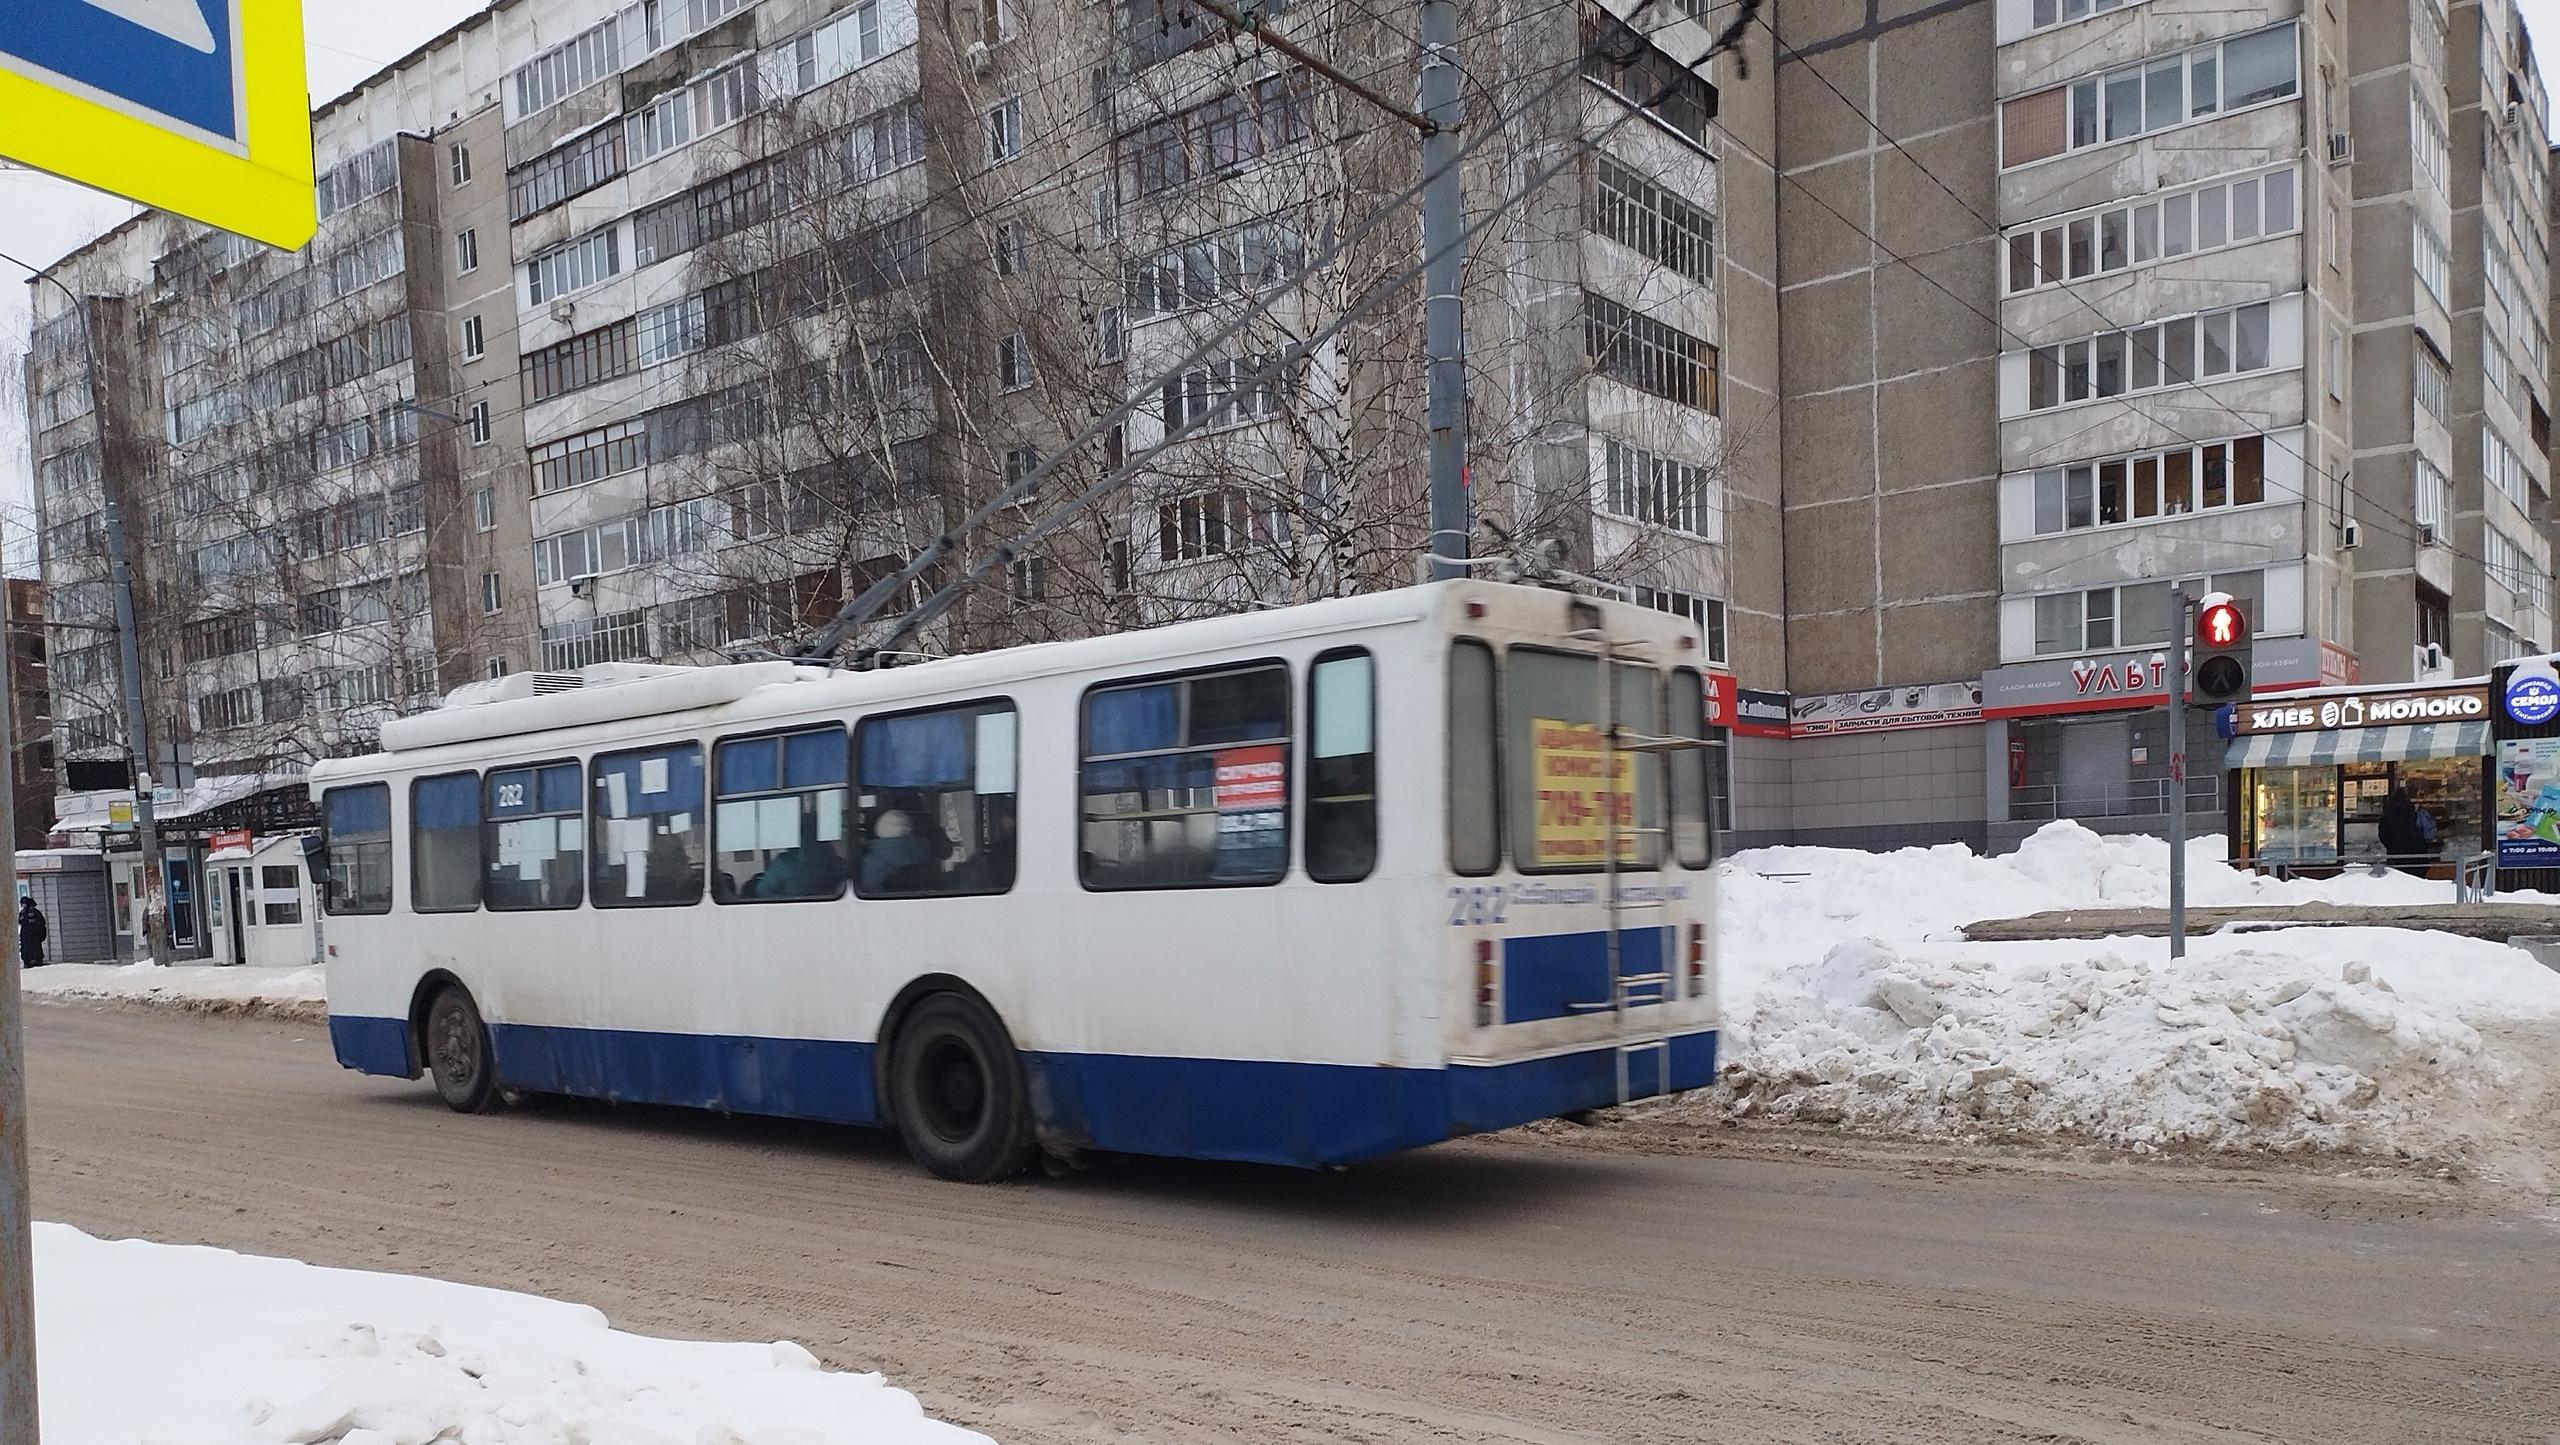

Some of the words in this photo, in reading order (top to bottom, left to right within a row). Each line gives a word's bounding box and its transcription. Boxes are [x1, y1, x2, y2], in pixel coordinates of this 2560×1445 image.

[1838, 719, 1880, 729] ЗАПЧАСТИ
[1881, 717, 1900, 728] ДЛЯ
[1902, 711, 1944, 723] БЫТОВОЙ
[2251, 708, 2315, 729] ХЛЕБ
[2370, 695, 2483, 720] МОЛОКО
[1806, 724, 1829, 732] ТЭНЫ
[498, 783, 524, 807] 282
[1448, 886, 1507, 926] 282
